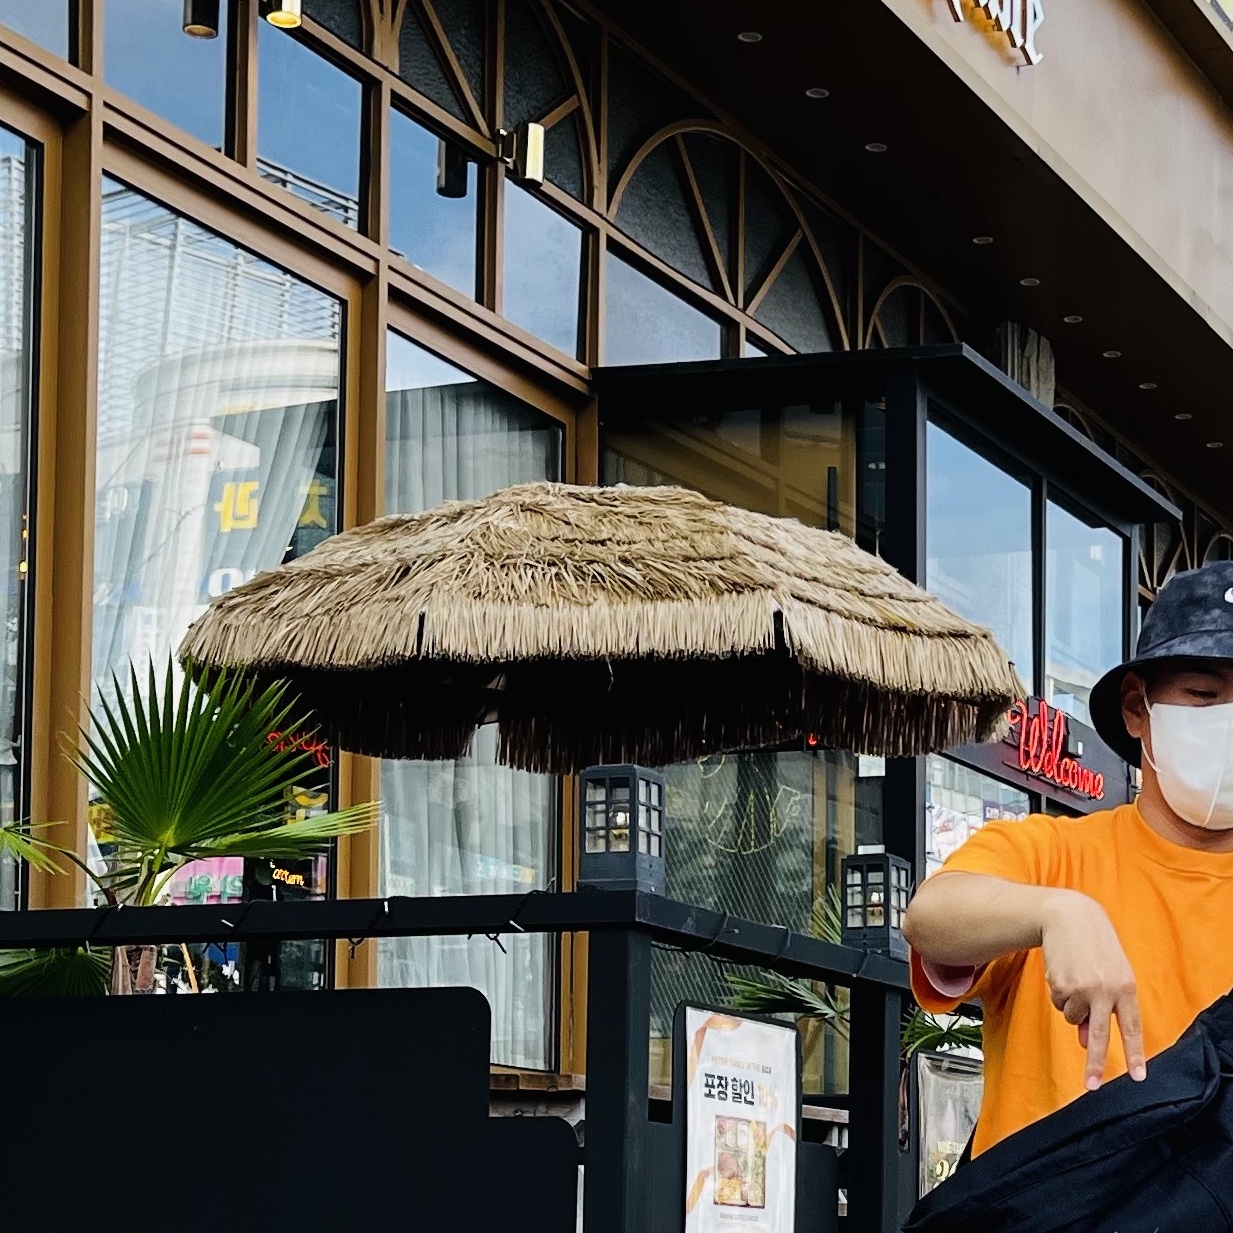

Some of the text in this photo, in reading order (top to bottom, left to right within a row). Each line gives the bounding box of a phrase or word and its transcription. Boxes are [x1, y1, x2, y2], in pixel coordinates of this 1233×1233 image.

[1006, 698, 1105, 801] Welcome
[704, 1072, 729, 1102] 포장
[731, 1077, 755, 1106] 할인
